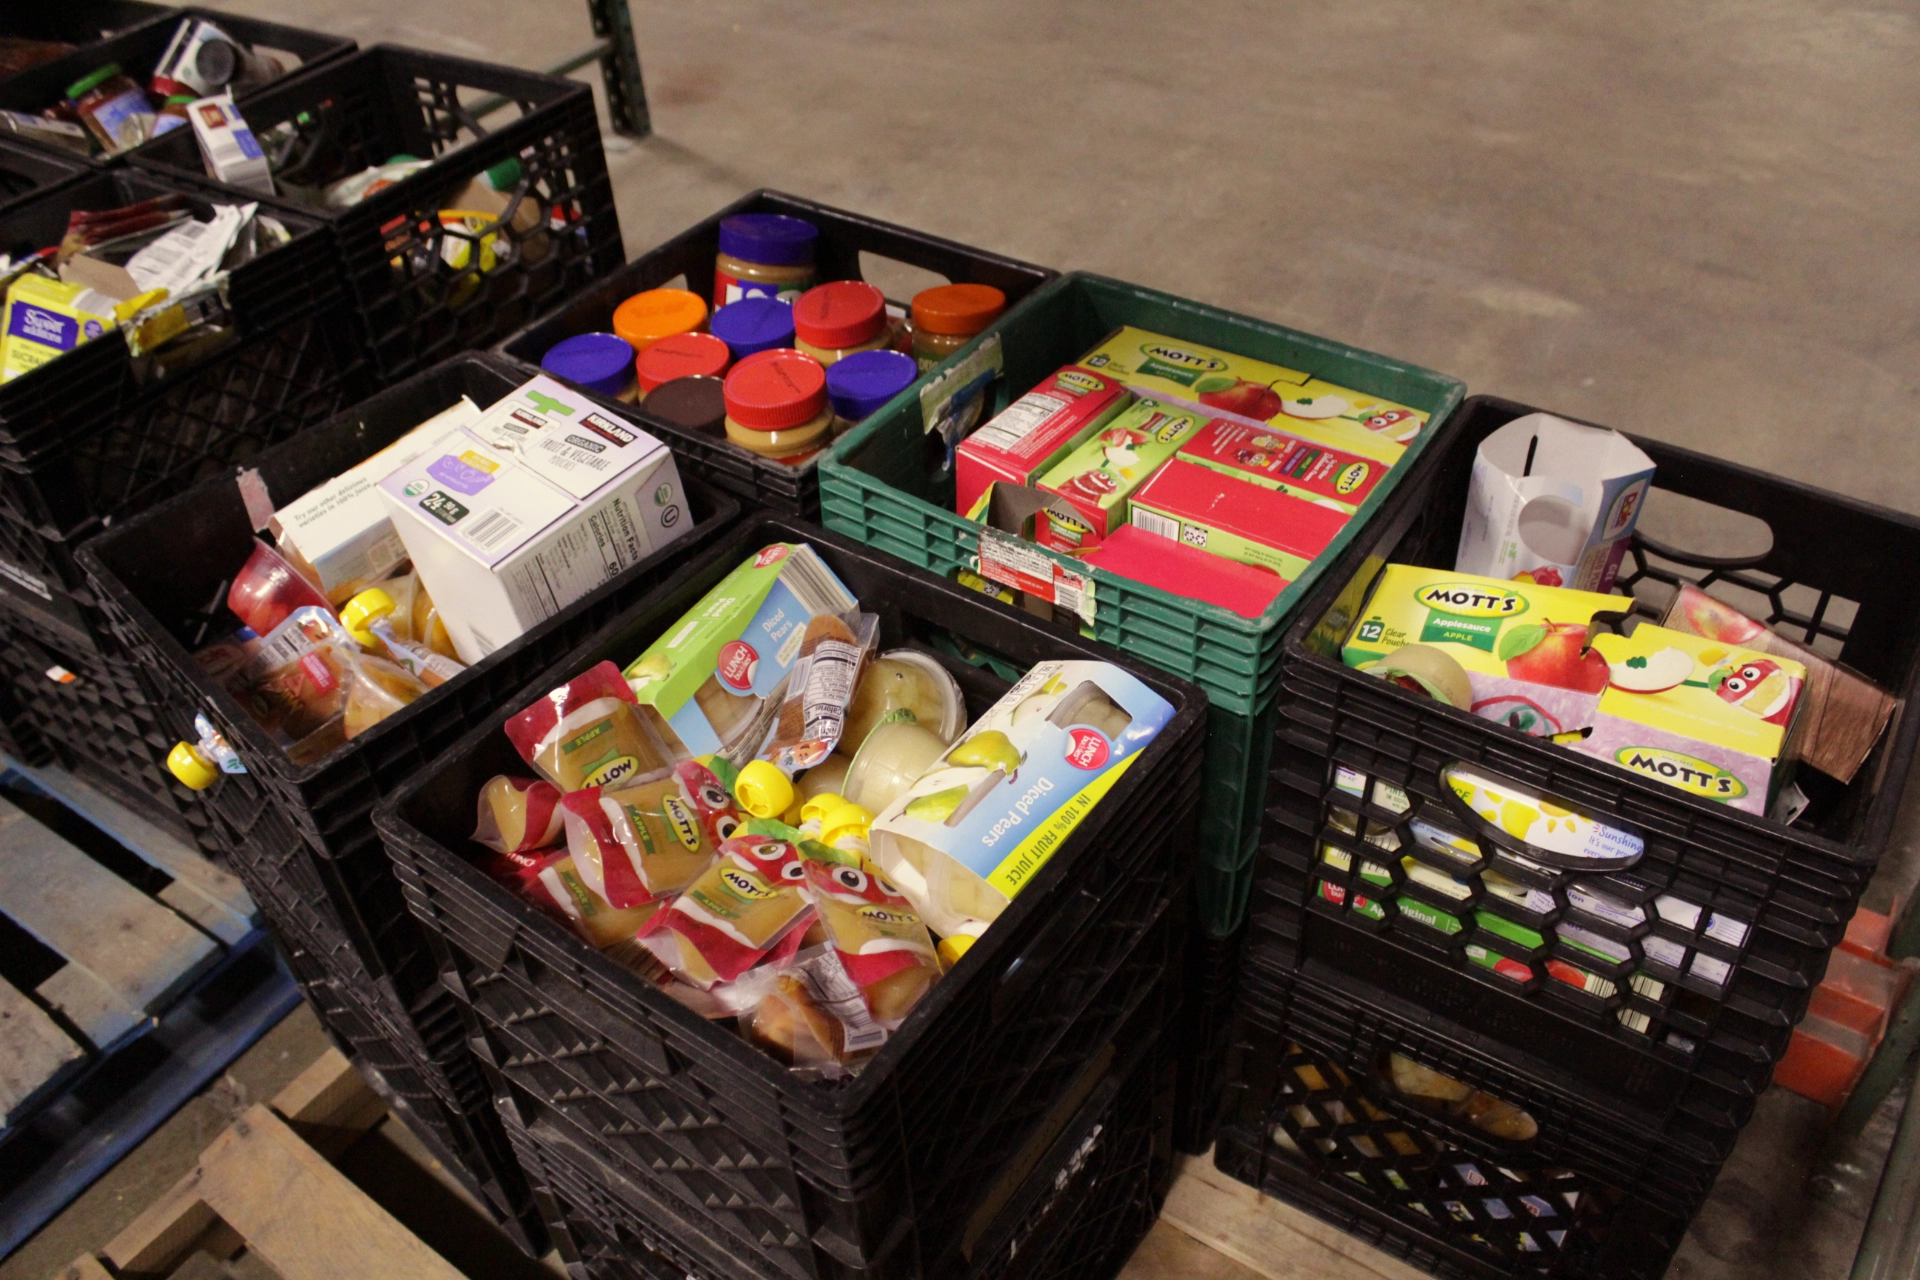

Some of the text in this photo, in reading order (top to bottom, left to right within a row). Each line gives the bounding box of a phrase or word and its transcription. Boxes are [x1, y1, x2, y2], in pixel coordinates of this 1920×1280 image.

[586, 413, 635, 444] KIRKLAND
[540, 438, 611, 472] FRUIT & VEGETABLE
[567, 434, 605, 454] ORGANIC
[338, 477, 367, 497] delicious
[423, 492, 446, 511] 24
[1619, 491, 1638, 527] Dole
[298, 510, 327, 528] varieties
[612, 498, 639, 561] Nutrition Facts
[590, 514, 620, 576] Calories 60
[1605, 563, 1618, 582] GEL
[1426, 589, 1516, 612] MOTT'S
[762, 608, 785, 633] Diced
[770, 621, 793, 643] Pears
[1362, 624, 1407, 639] 12 Clear
[1433, 617, 1492, 633] Applesauce
[1381, 637, 1415, 648] Pouche
[1443, 631, 1474, 642] APPLE
[724, 645, 748, 678] LUNCH
[575, 727, 601, 746] APPLE
[1079, 736, 1102, 767] LUNCH
[585, 759, 632, 789] MOTT
[1629, 753, 1732, 793] MOTT'S
[982, 776, 1055, 847] Diced Pears
[633, 815, 650, 841] APPLE
[1005, 793, 1092, 886] IN 100% FRUIT JUICE
[1599, 825, 1644, 852] Sunshine
[1588, 836, 1601, 848] It's
[1602, 843, 1615, 853] our
[702, 899, 729, 916] APPLE
[1568, 892, 1584, 903] ion
[1400, 903, 1437, 926] riginal
